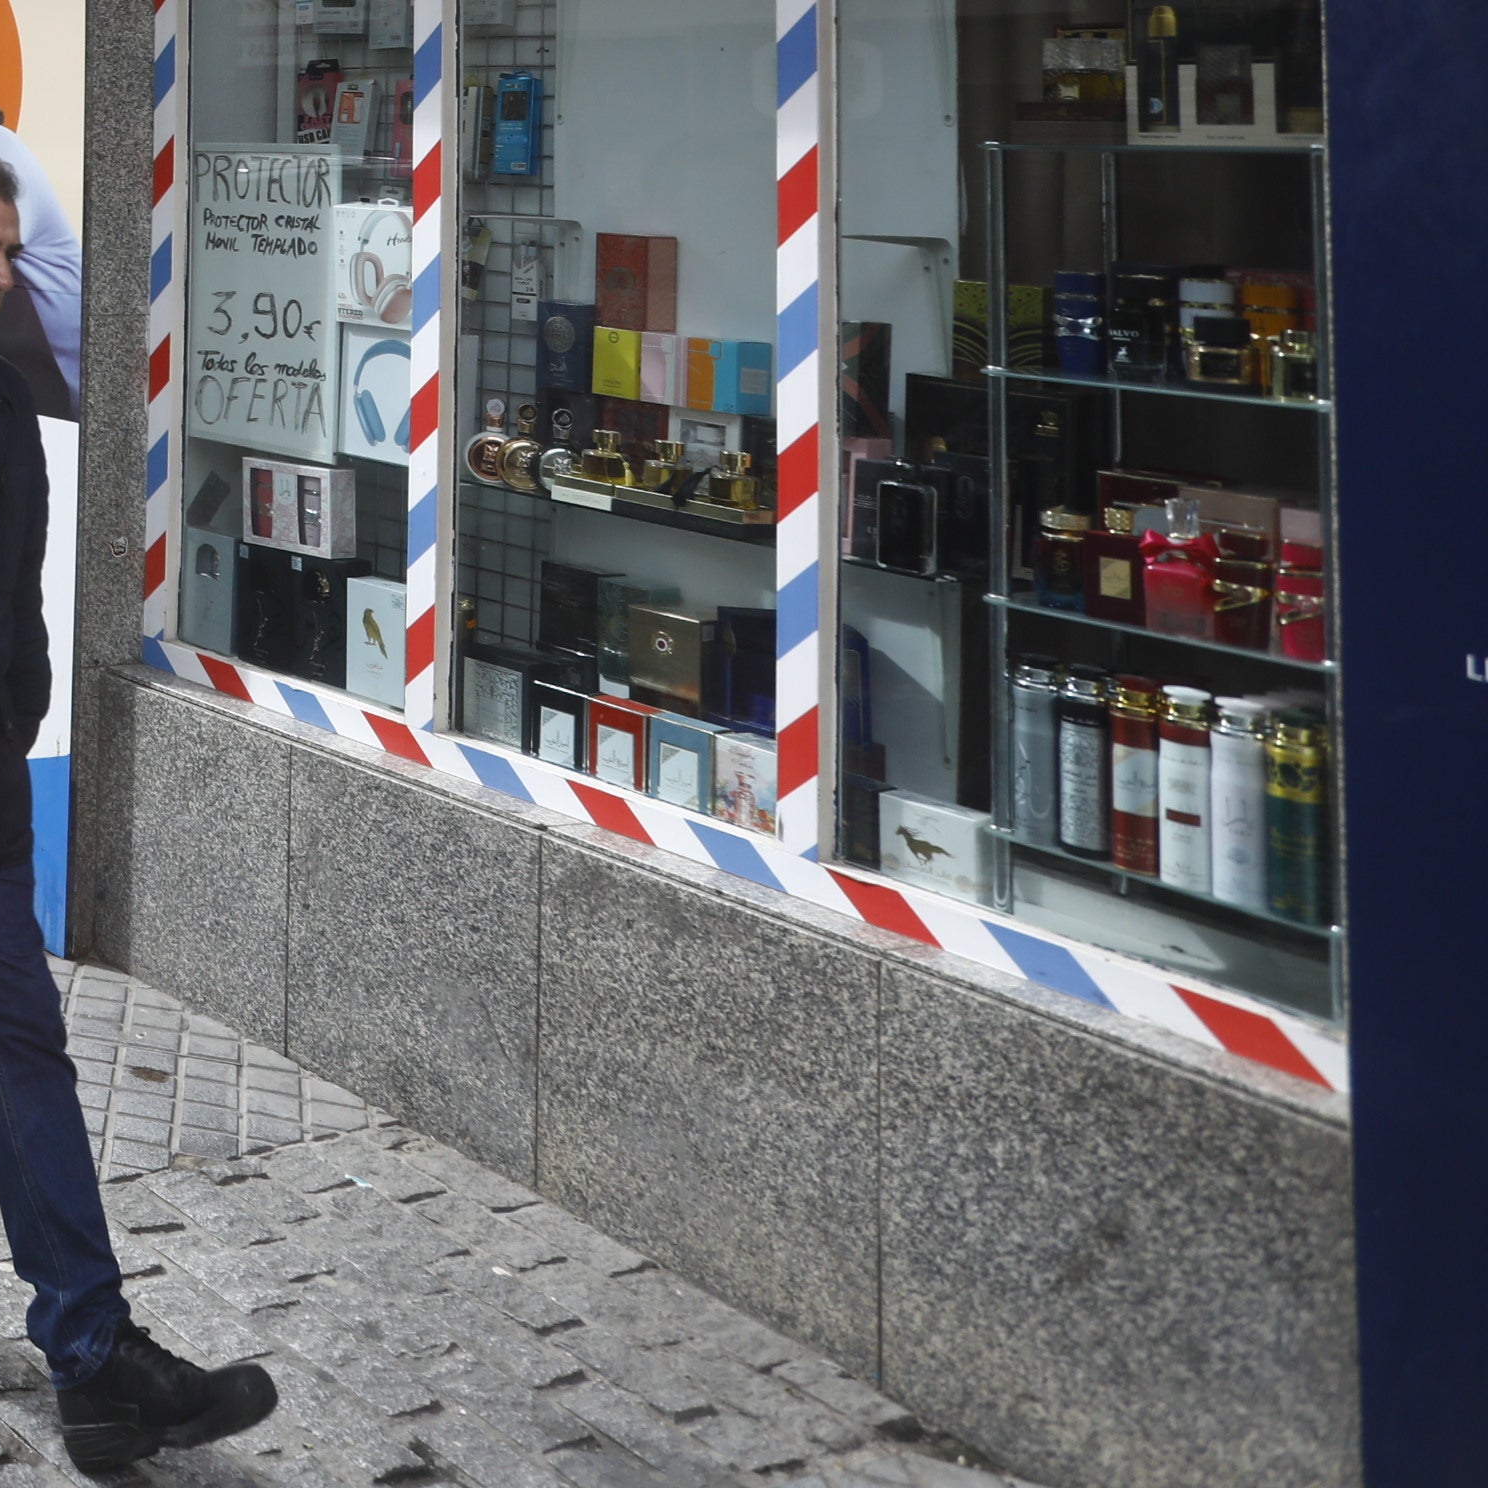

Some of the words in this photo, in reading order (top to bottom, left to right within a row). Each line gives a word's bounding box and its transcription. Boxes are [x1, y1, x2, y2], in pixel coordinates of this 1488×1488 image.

[195, 153, 331, 209] PROTECTOR
[204, 208, 269, 233] PROTECTOR
[275, 214, 321, 230] CRISTAL
[206, 231, 240, 252] MOVIL
[252, 234, 318, 258] TEMPLADO
[197, 350, 238, 372] Todos
[245, 352, 269, 376] los
[274, 359, 326, 381] modelos
[195, 375, 326, 438] OFERTA
